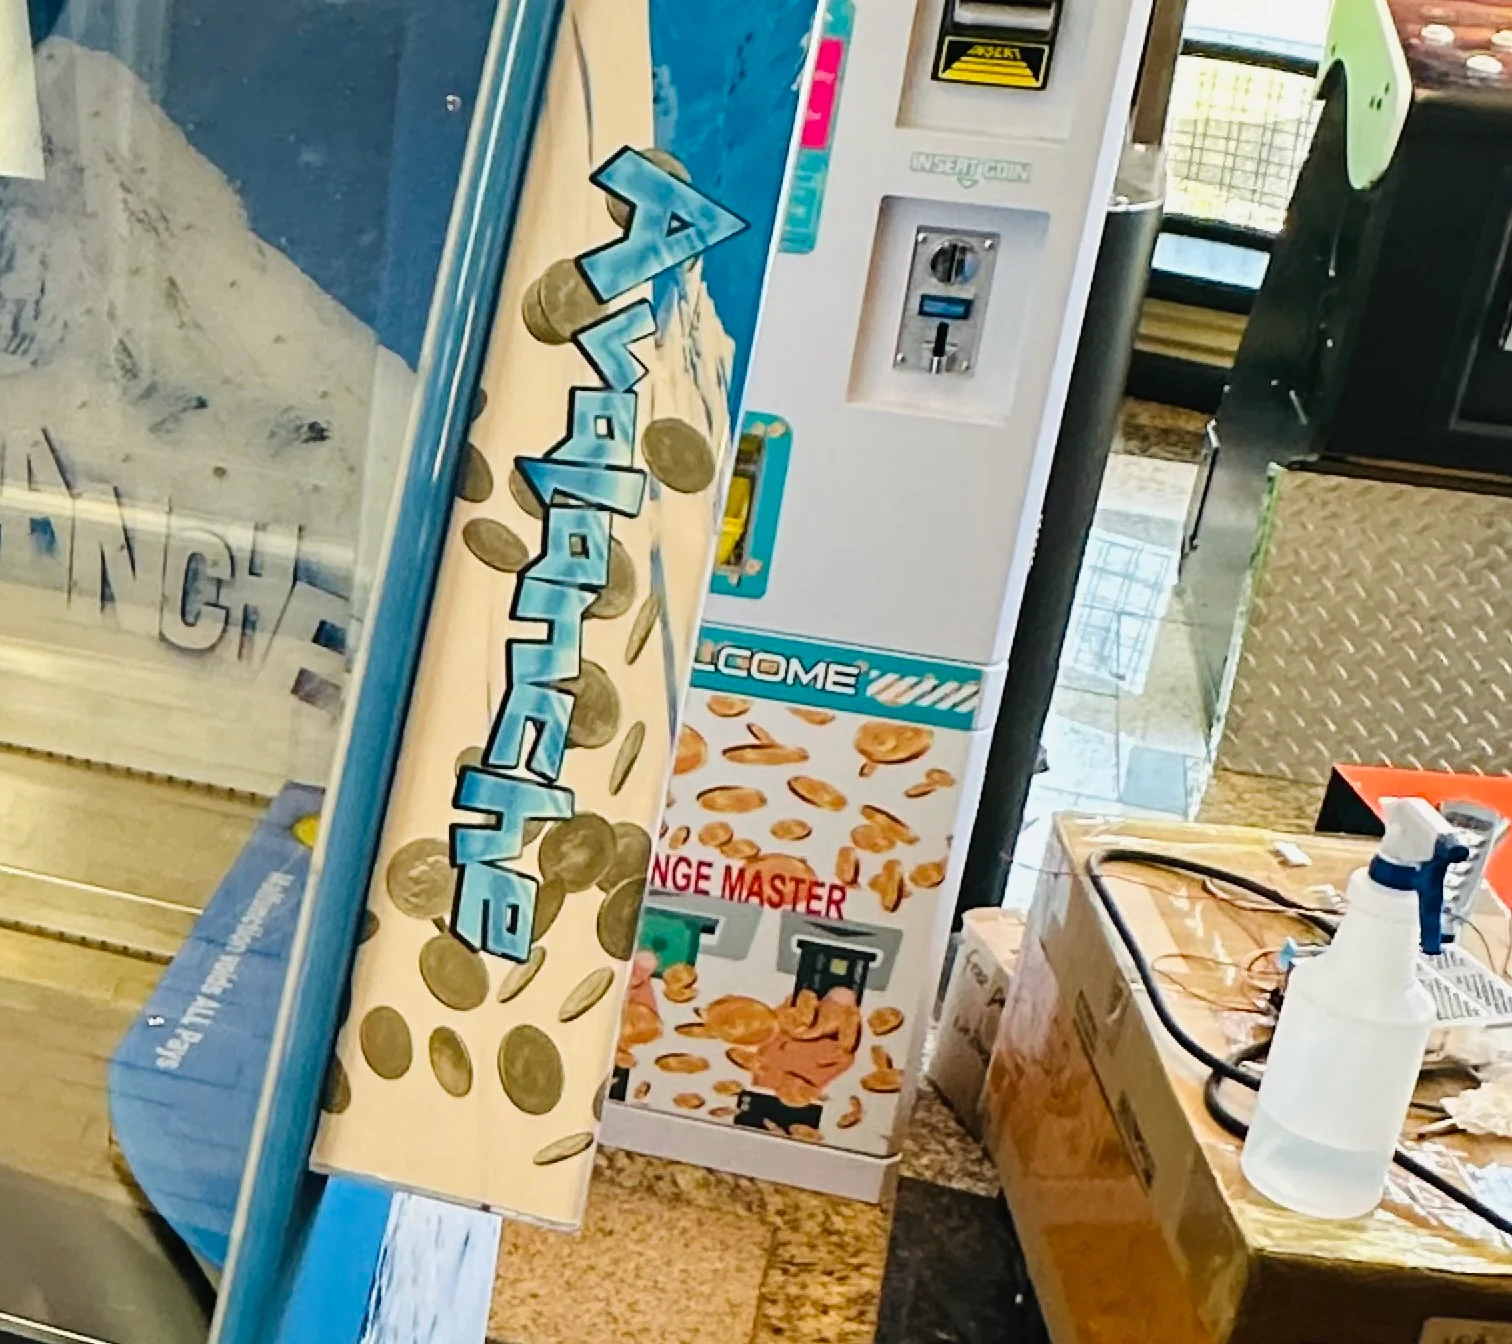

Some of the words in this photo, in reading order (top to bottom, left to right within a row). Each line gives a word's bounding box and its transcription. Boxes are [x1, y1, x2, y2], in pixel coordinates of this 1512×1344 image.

[910, 152, 981, 178] INSERT
[981, 157, 1032, 184] COIN
[450, 145, 750, 964] Avalanche
[694, 644, 862, 696] COME
[650, 852, 713, 896] NGE
[721, 864, 847, 920] MASTER
[181, 994, 222, 1027] ALL
[155, 1027, 205, 1071] Pays
